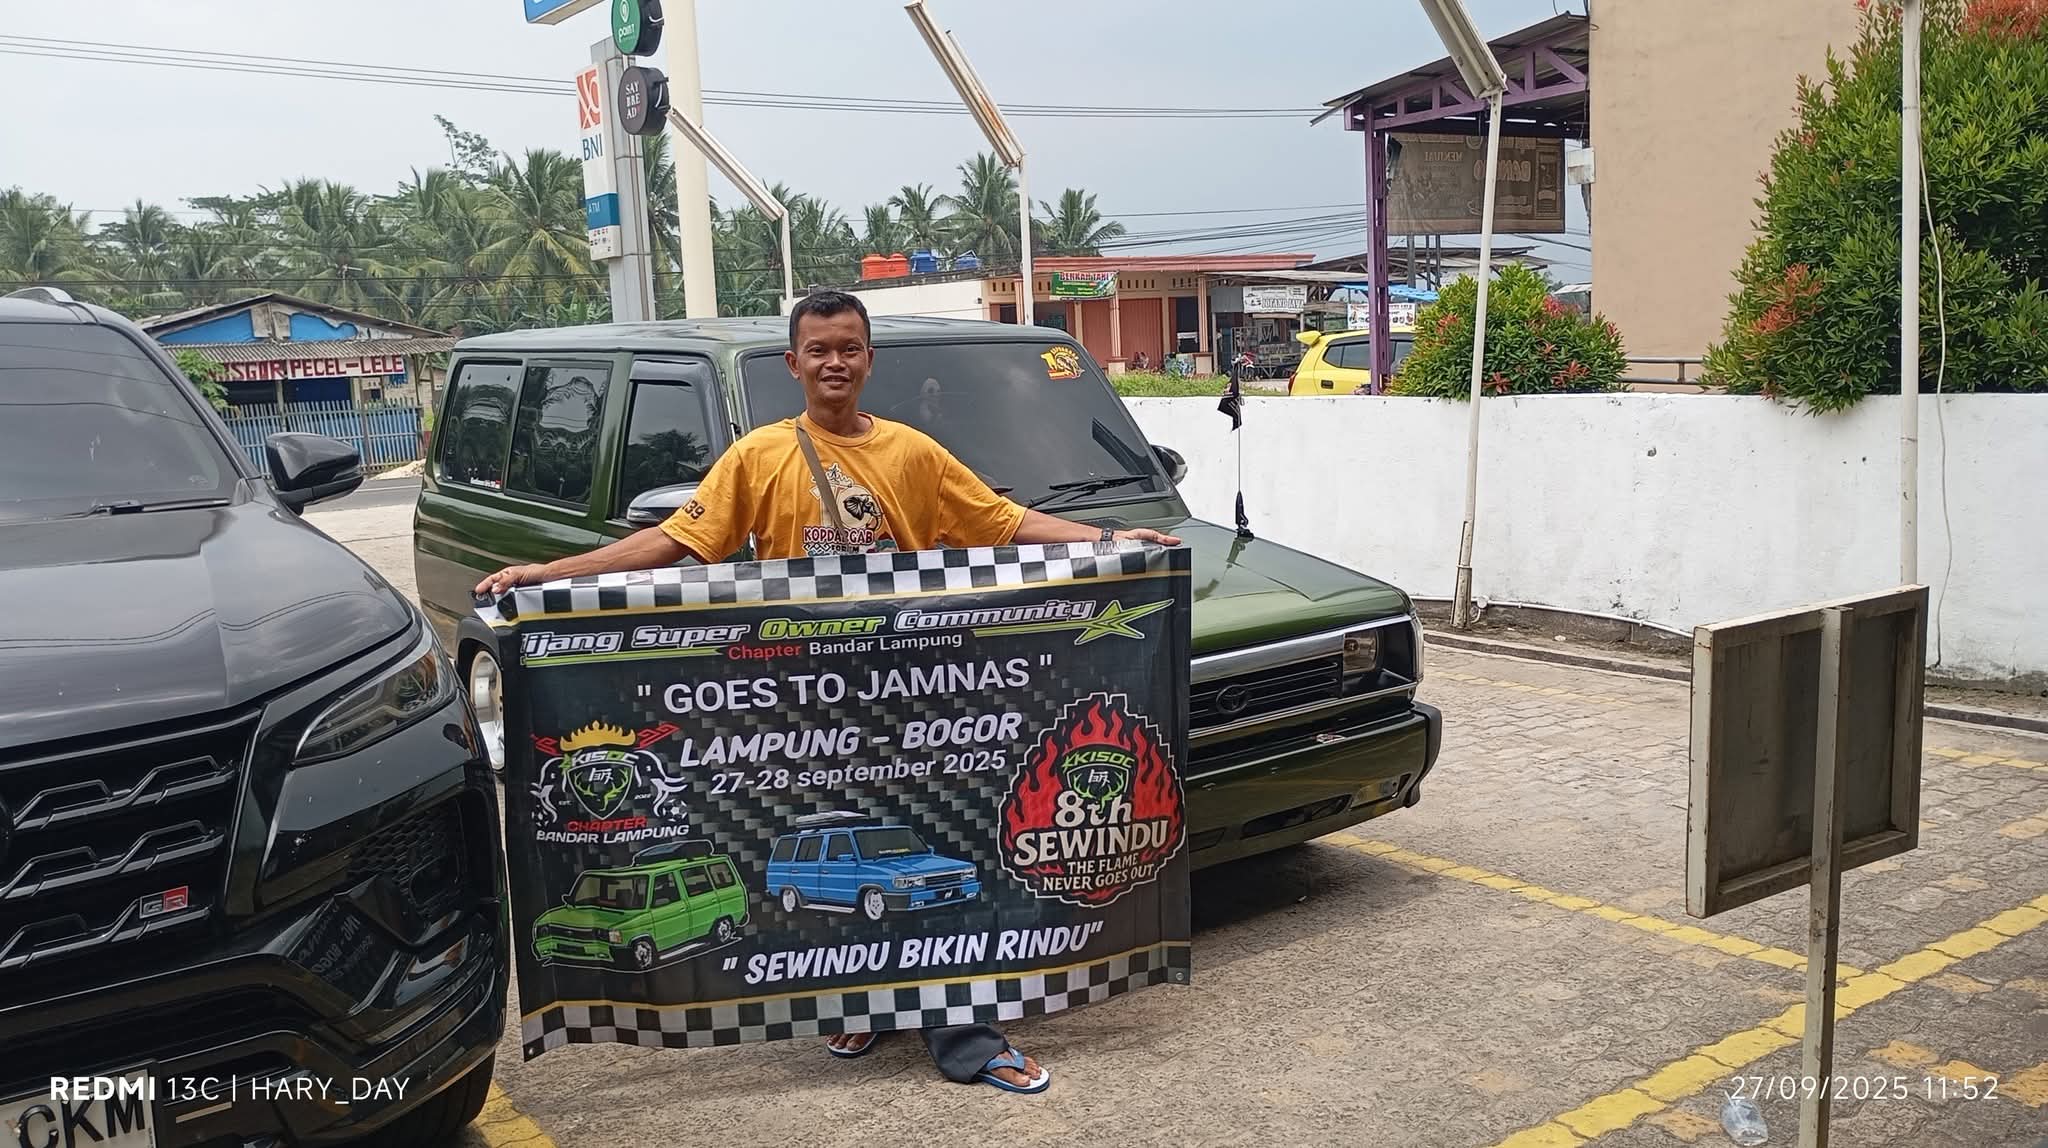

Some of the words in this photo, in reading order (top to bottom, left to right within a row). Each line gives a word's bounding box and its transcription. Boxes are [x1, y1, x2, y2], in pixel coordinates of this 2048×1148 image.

[626, 81, 640, 95] SAY
[626, 94, 641, 107] BRE
[582, 133, 603, 160] BNI
[521, 631, 624, 657] ijang
[632, 624, 750, 648] Super
[758, 615, 886, 640] Owner
[893, 600, 1096, 632] Community
[728, 643, 801, 661] Chapter
[809, 639, 874, 656] Bandar
[880, 633, 962, 651] Lampung
[664, 678, 778, 713] GOES
[788, 674, 846, 705] TO
[857, 658, 1030, 700] JAMNAS
[680, 726, 860, 768] LAMPUNG
[902, 712, 1023, 750] BOGOR
[711, 768, 790, 795] 27-28
[797, 758, 935, 789] september
[943, 749, 1007, 775] 2025
[1055, 790, 1132, 828] 8th
[536, 829, 599, 844] BANDAR
[603, 825, 690, 844] LAMPUNG
[567, 816, 649, 832] CHAPTER
[1013, 821, 1169, 866] SEWINDU
[1043, 875, 1093, 891] NEVER
[1095, 871, 1128, 888] GOES
[1130, 863, 1154, 878] OUT
[1067, 861, 1095, 876] THE
[1099, 853, 1139, 872] FLAME
[143, 895, 185, 913] GR
[744, 941, 891, 985] SEWINDU
[899, 932, 988, 969] BIKIN
[18, 1081, 146, 1148] CKM
